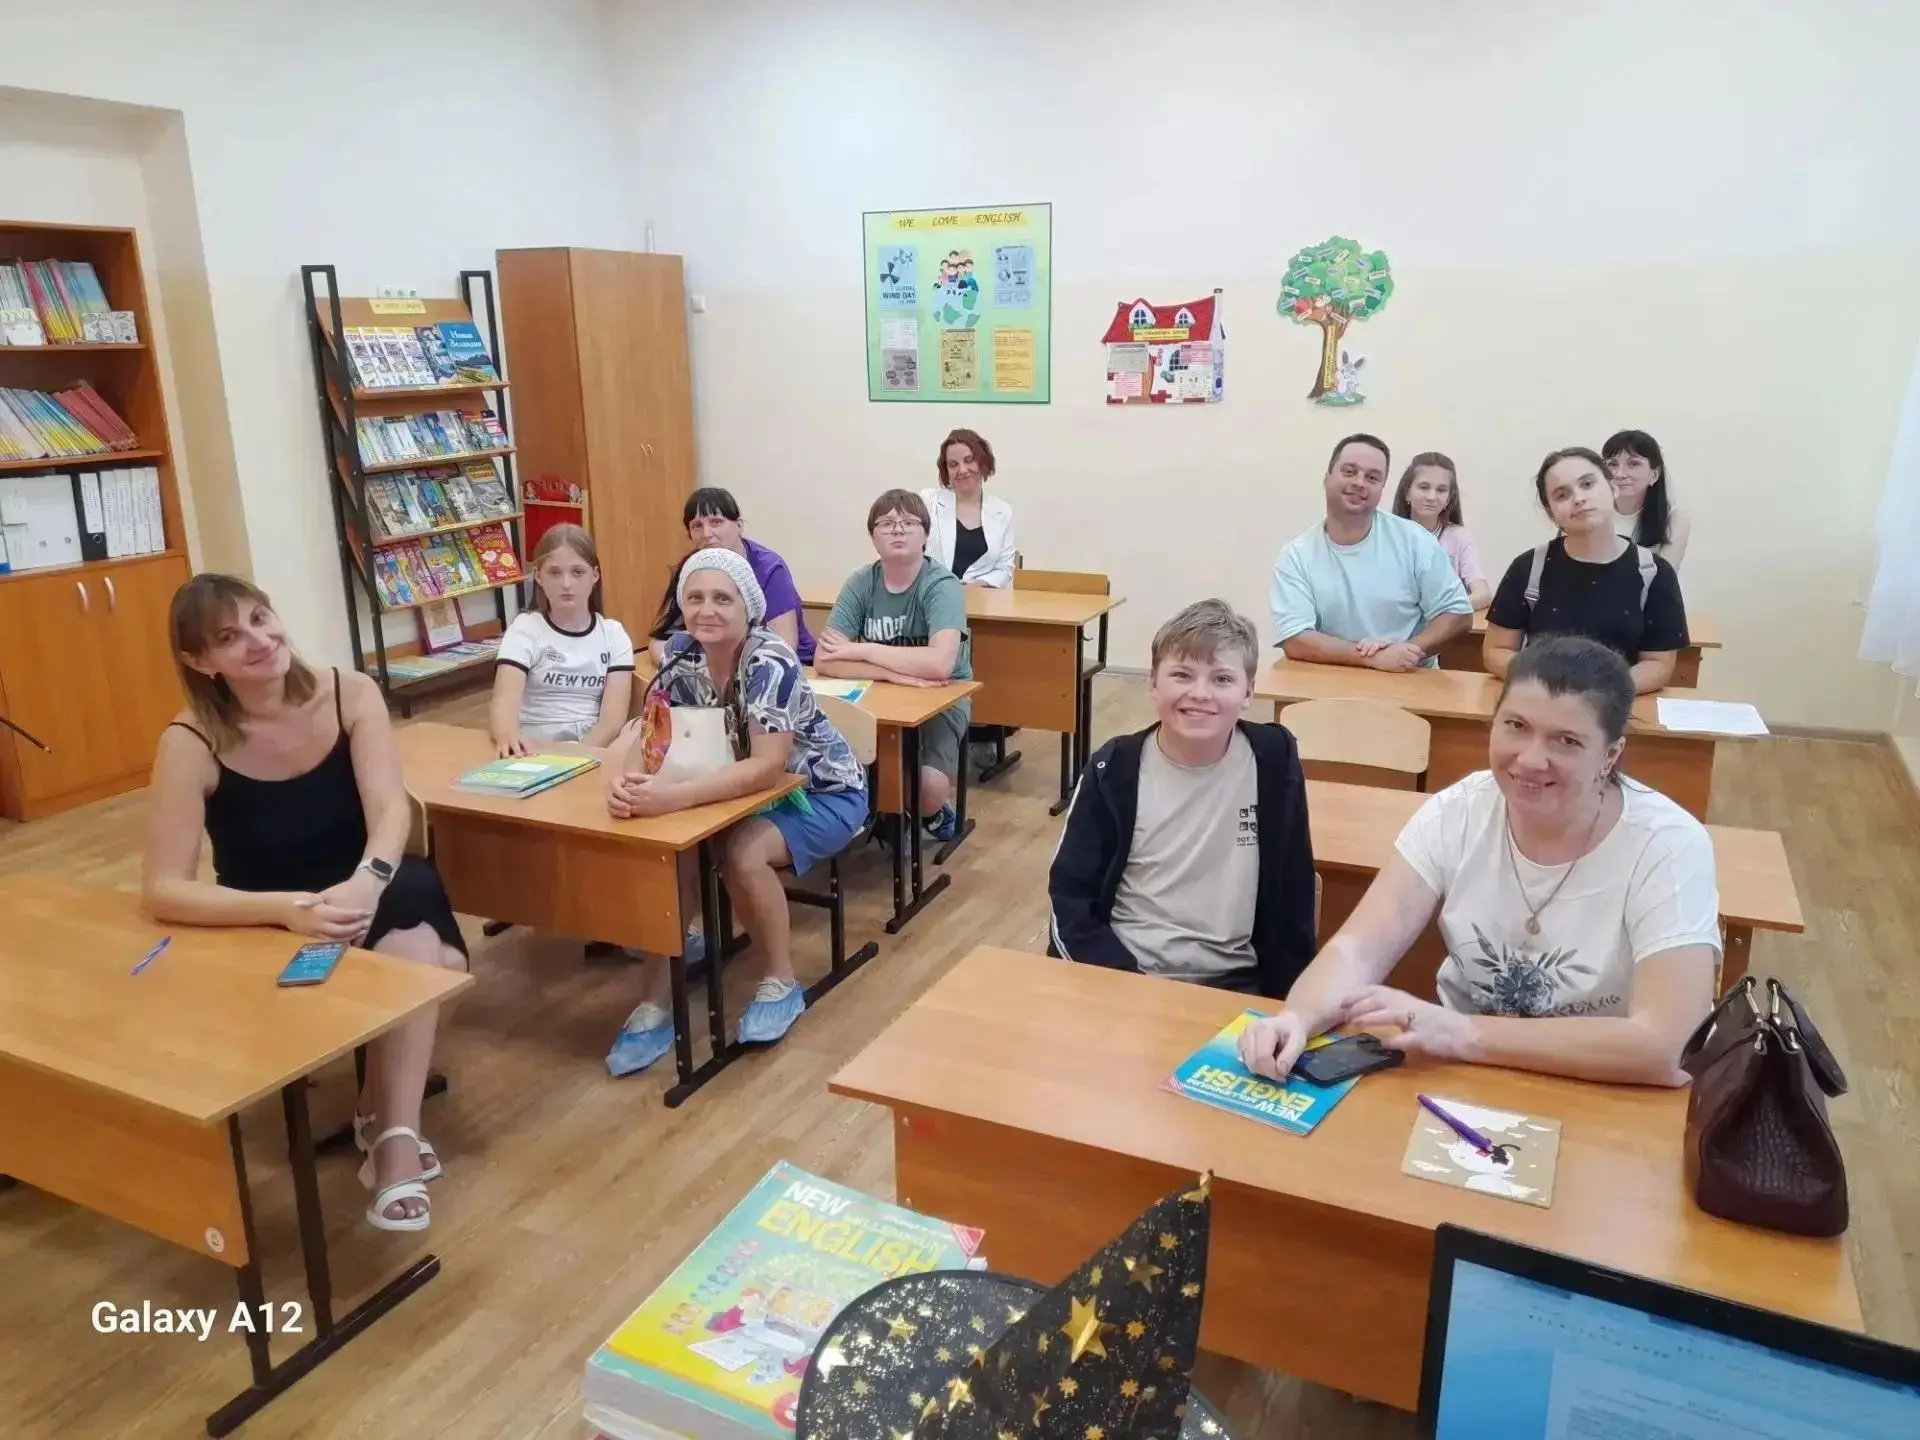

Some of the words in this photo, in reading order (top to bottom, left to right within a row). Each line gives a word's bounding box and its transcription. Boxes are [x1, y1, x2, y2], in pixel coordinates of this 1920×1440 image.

[899, 219, 914, 228] WE
[932, 216, 959, 226] LOVE
[975, 211, 1023, 224] ENGLISH
[543, 672, 578, 687] NEW
[581, 675, 606, 688] YOR
[1191, 1065, 1316, 1111] ENGLISH
[1254, 1100, 1303, 1121] NEW
[784, 1180, 851, 1216] NEW
[756, 1199, 946, 1278] ENGLISH
